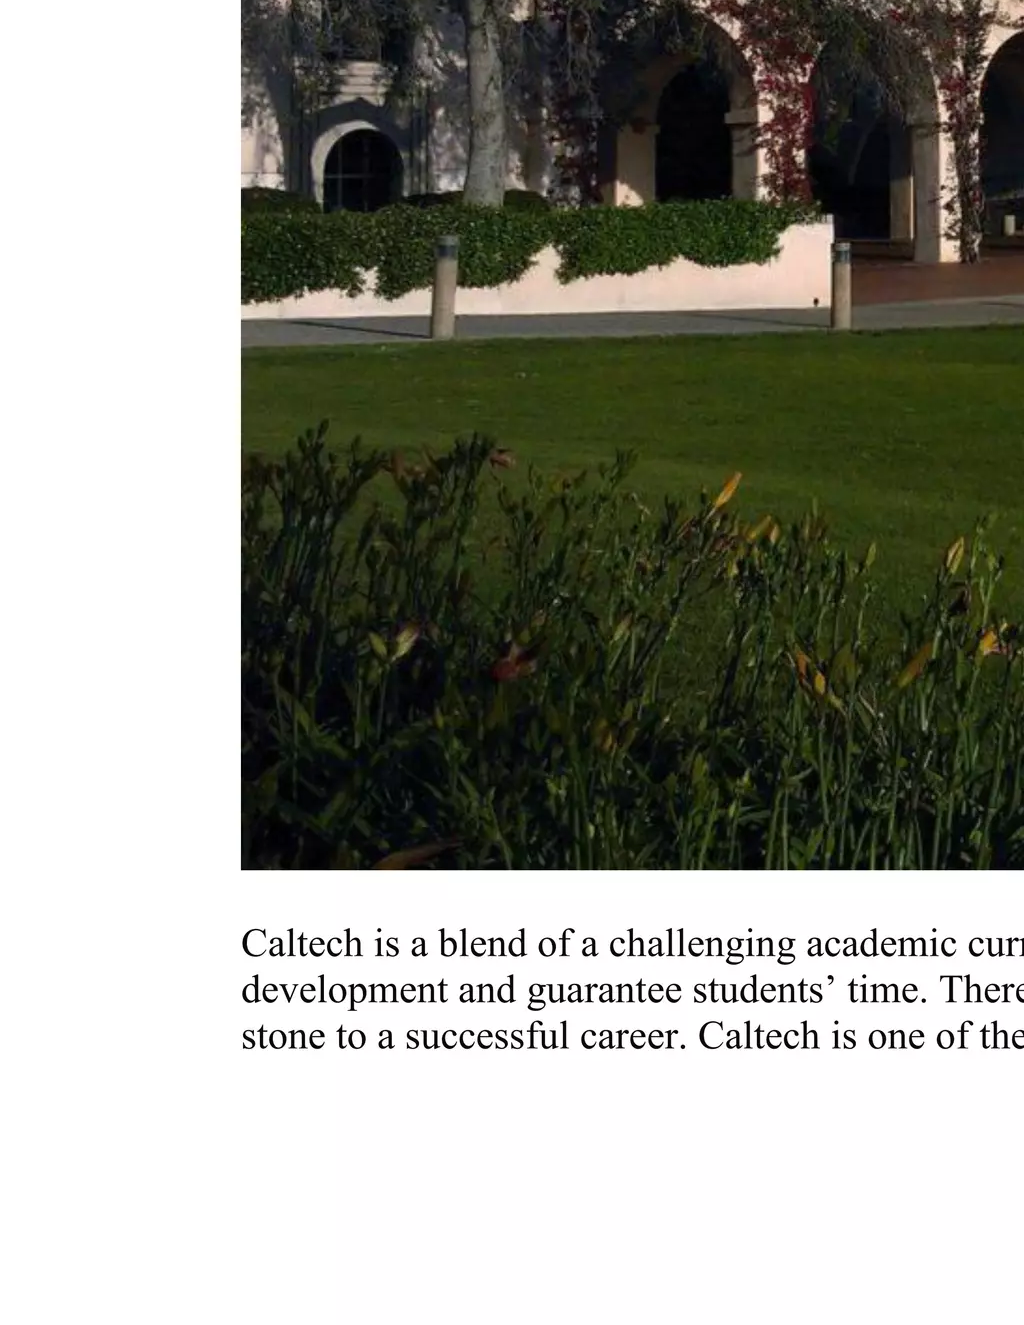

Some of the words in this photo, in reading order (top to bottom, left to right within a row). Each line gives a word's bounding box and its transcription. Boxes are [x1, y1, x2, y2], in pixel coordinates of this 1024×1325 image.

[242, 928, 363, 957] Caltech
[375, 928, 399, 957] is
[412, 937, 428, 957] a
[438, 928, 527, 957] blend
[539, 928, 575, 957] of
[582, 937, 598, 956] a
[610, 928, 795, 965] challenging
[808, 928, 956, 957] academic
[242, 974, 448, 1011] development
[460, 974, 516, 1003] and
[528, 979, 681, 1011] guarantee
[694, 974, 834, 1003] students’
[848, 974, 926, 1003] time.
[243, 1025, 325, 1049] stone
[336, 1025, 366, 1049] to
[379, 1030, 395, 1049] a
[407, 1020, 568, 1049] successful
[581, 1030, 685, 1049] career.
[699, 1021, 820, 1049] Caltech
[832, 1020, 856, 1049] is
[869, 1030, 924, 1049] one
[937, 1021, 973, 1049] of
